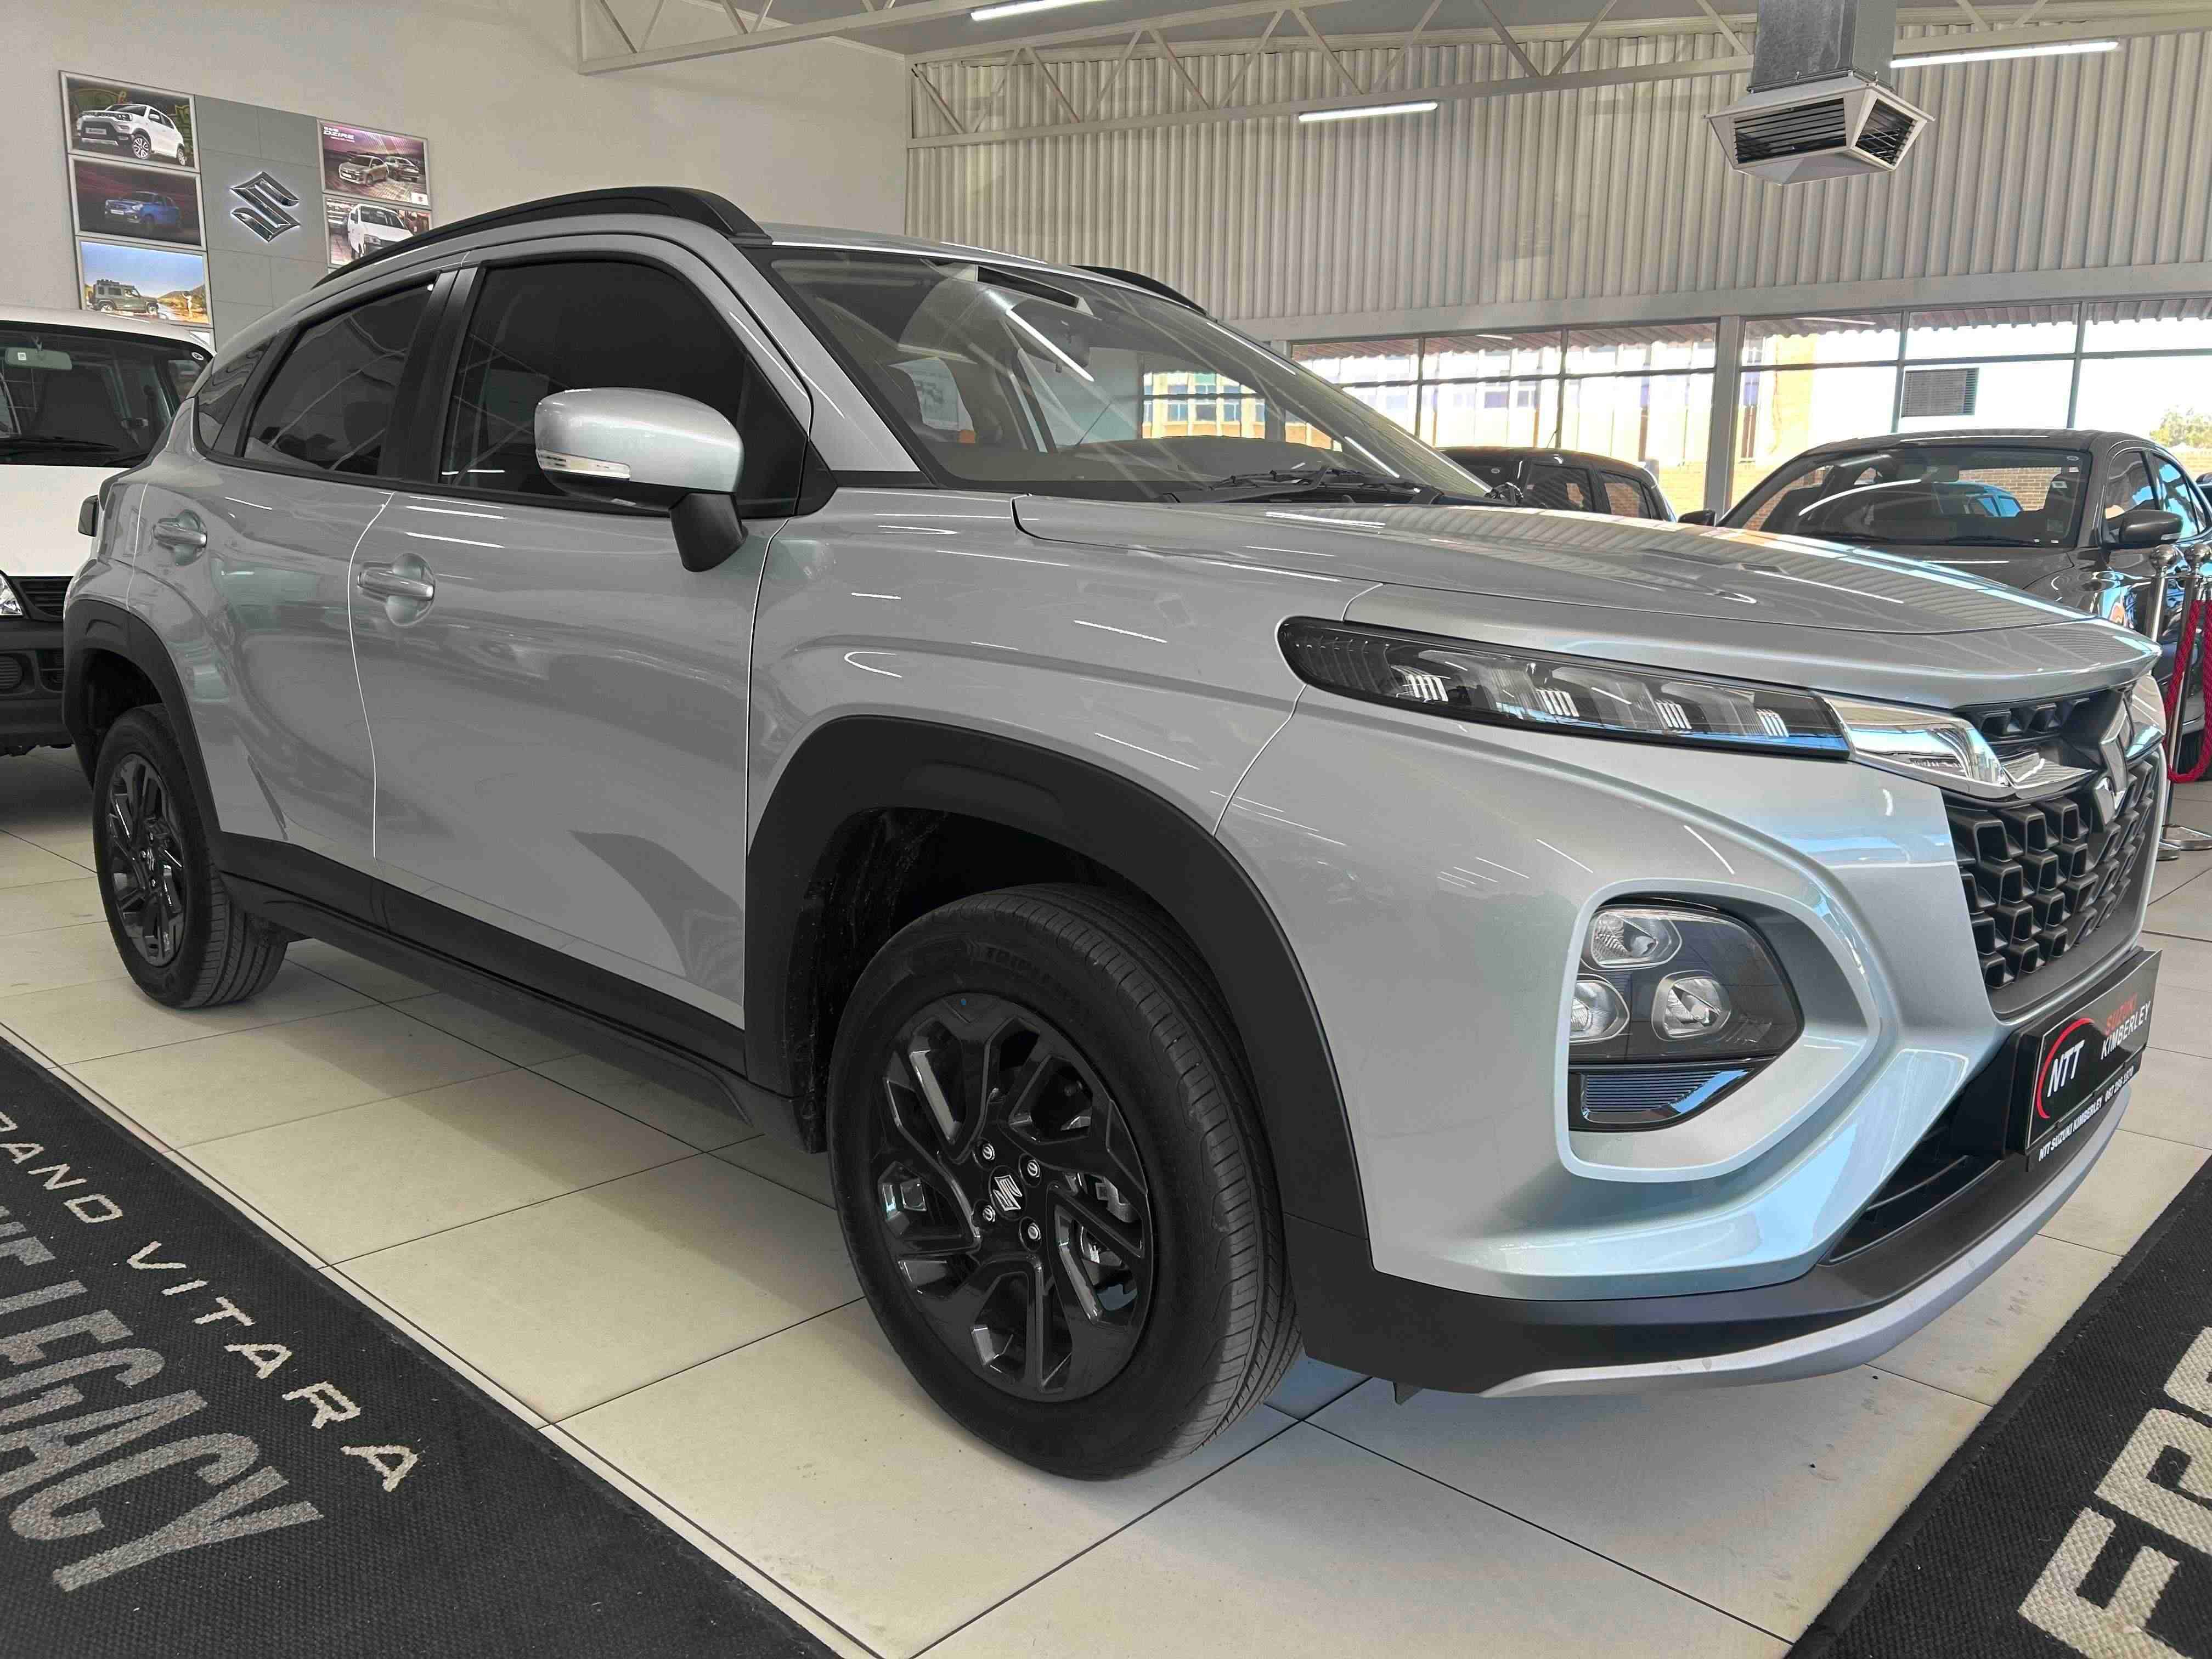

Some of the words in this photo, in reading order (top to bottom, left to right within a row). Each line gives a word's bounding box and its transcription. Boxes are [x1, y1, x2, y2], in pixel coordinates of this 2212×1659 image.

[2101, 1000, 2151, 1060] KIMBERLEY
[2047, 1040, 2085, 1098] NTT
[2039, 1141, 2051, 1161] NTT
[2051, 1123, 2073, 1151] SUZUKI
[2073, 1096, 2103, 1132] KIMBERLEY
[127, 1241, 419, 1492] VITARA
